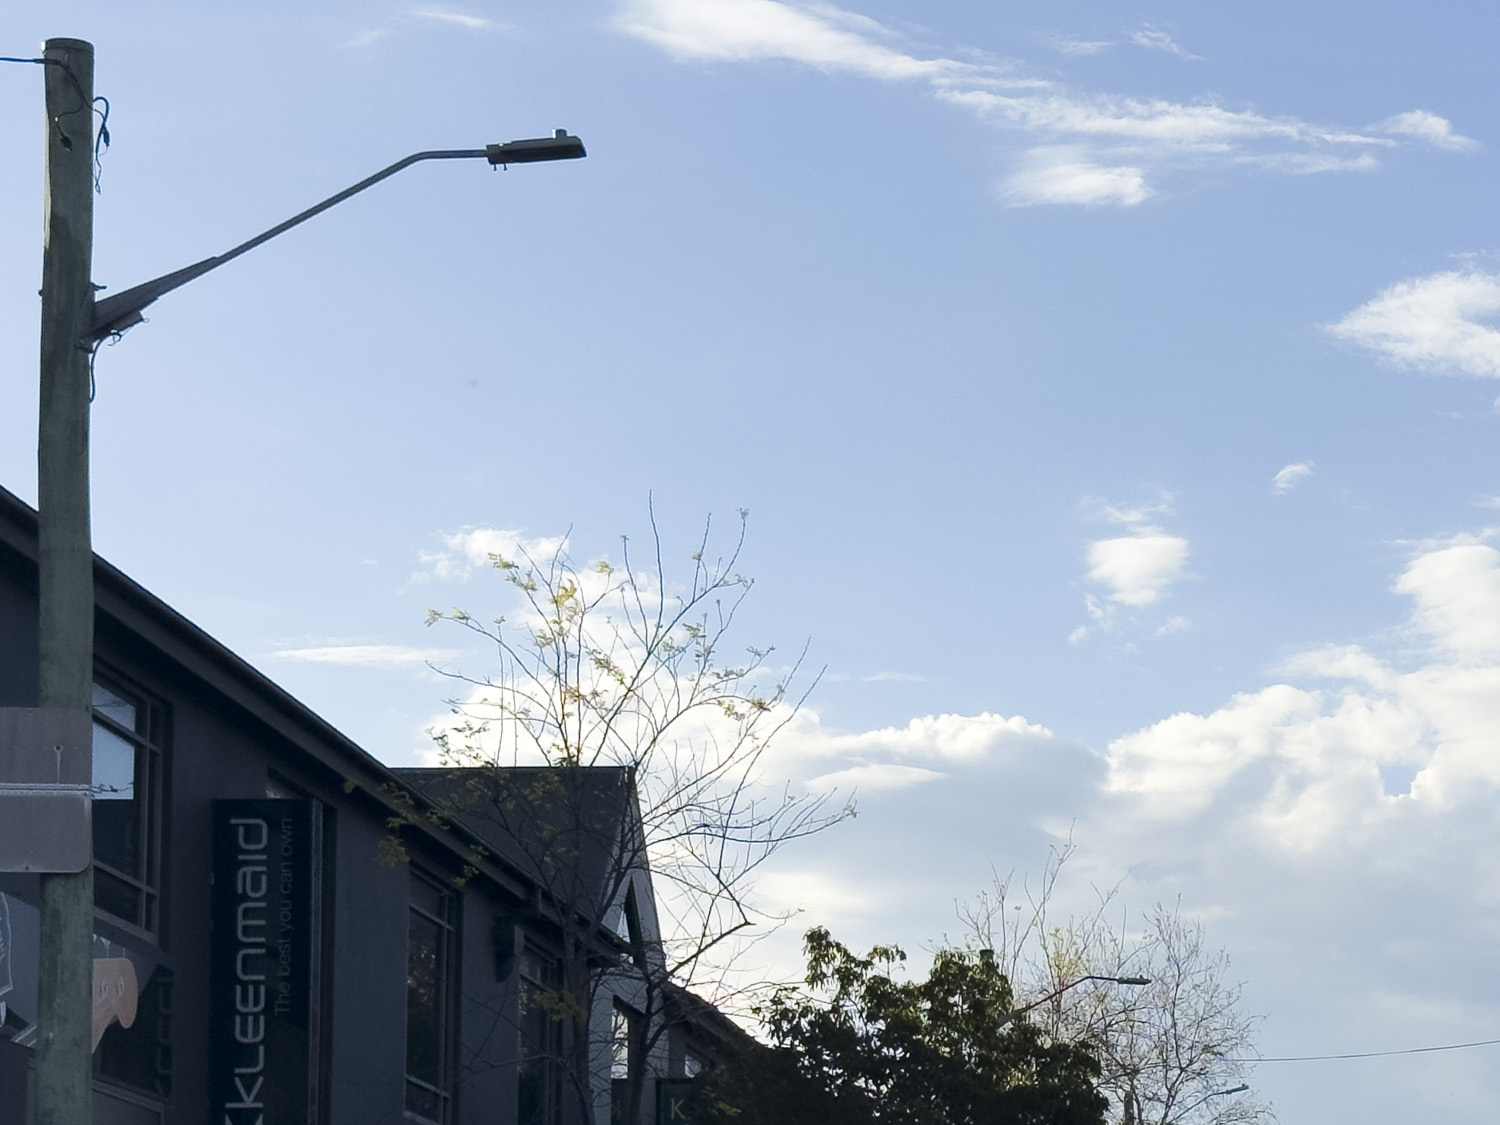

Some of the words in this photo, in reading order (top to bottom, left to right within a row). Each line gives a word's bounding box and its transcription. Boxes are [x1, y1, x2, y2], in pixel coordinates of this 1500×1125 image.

[281, 817, 293, 857] own
[279, 861, 293, 895] can
[279, 899, 295, 933] you
[275, 938, 291, 977] best
[274, 981, 290, 1016] The
